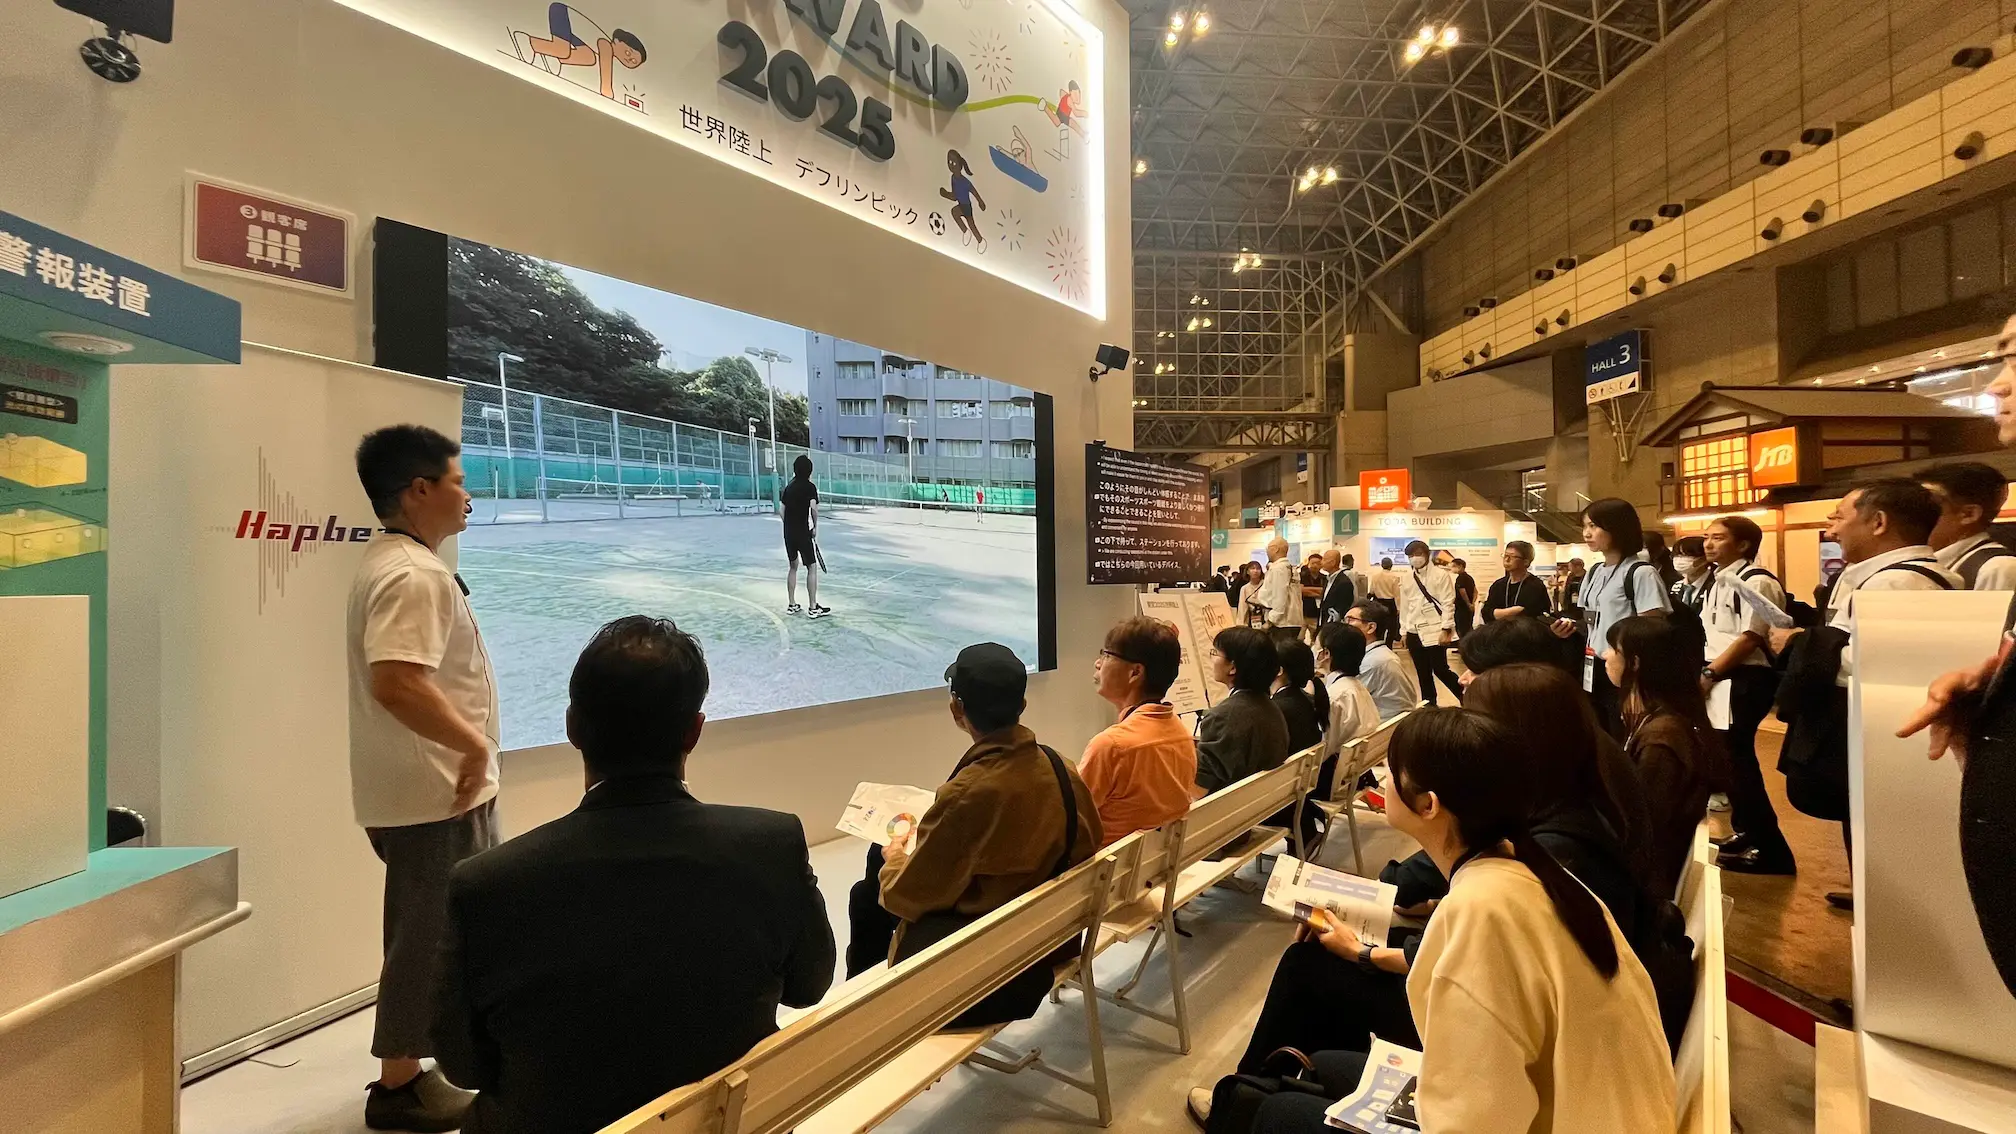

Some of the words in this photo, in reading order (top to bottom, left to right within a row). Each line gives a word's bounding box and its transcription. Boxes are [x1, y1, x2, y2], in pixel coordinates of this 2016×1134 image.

[717, 20, 895, 162] 2025
[679, 104, 773, 165] 世界陸上
[795, 157, 918, 225] デフリンピック
[0, 230, 151, 317] 警報装置
[1591, 357, 1616, 373] HALL
[1619, 344, 1631, 364] 3
[1753, 444, 1793, 473] JTB
[235, 510, 385, 552] Hapbe
[1411, 517, 1461, 526] BUILDING
